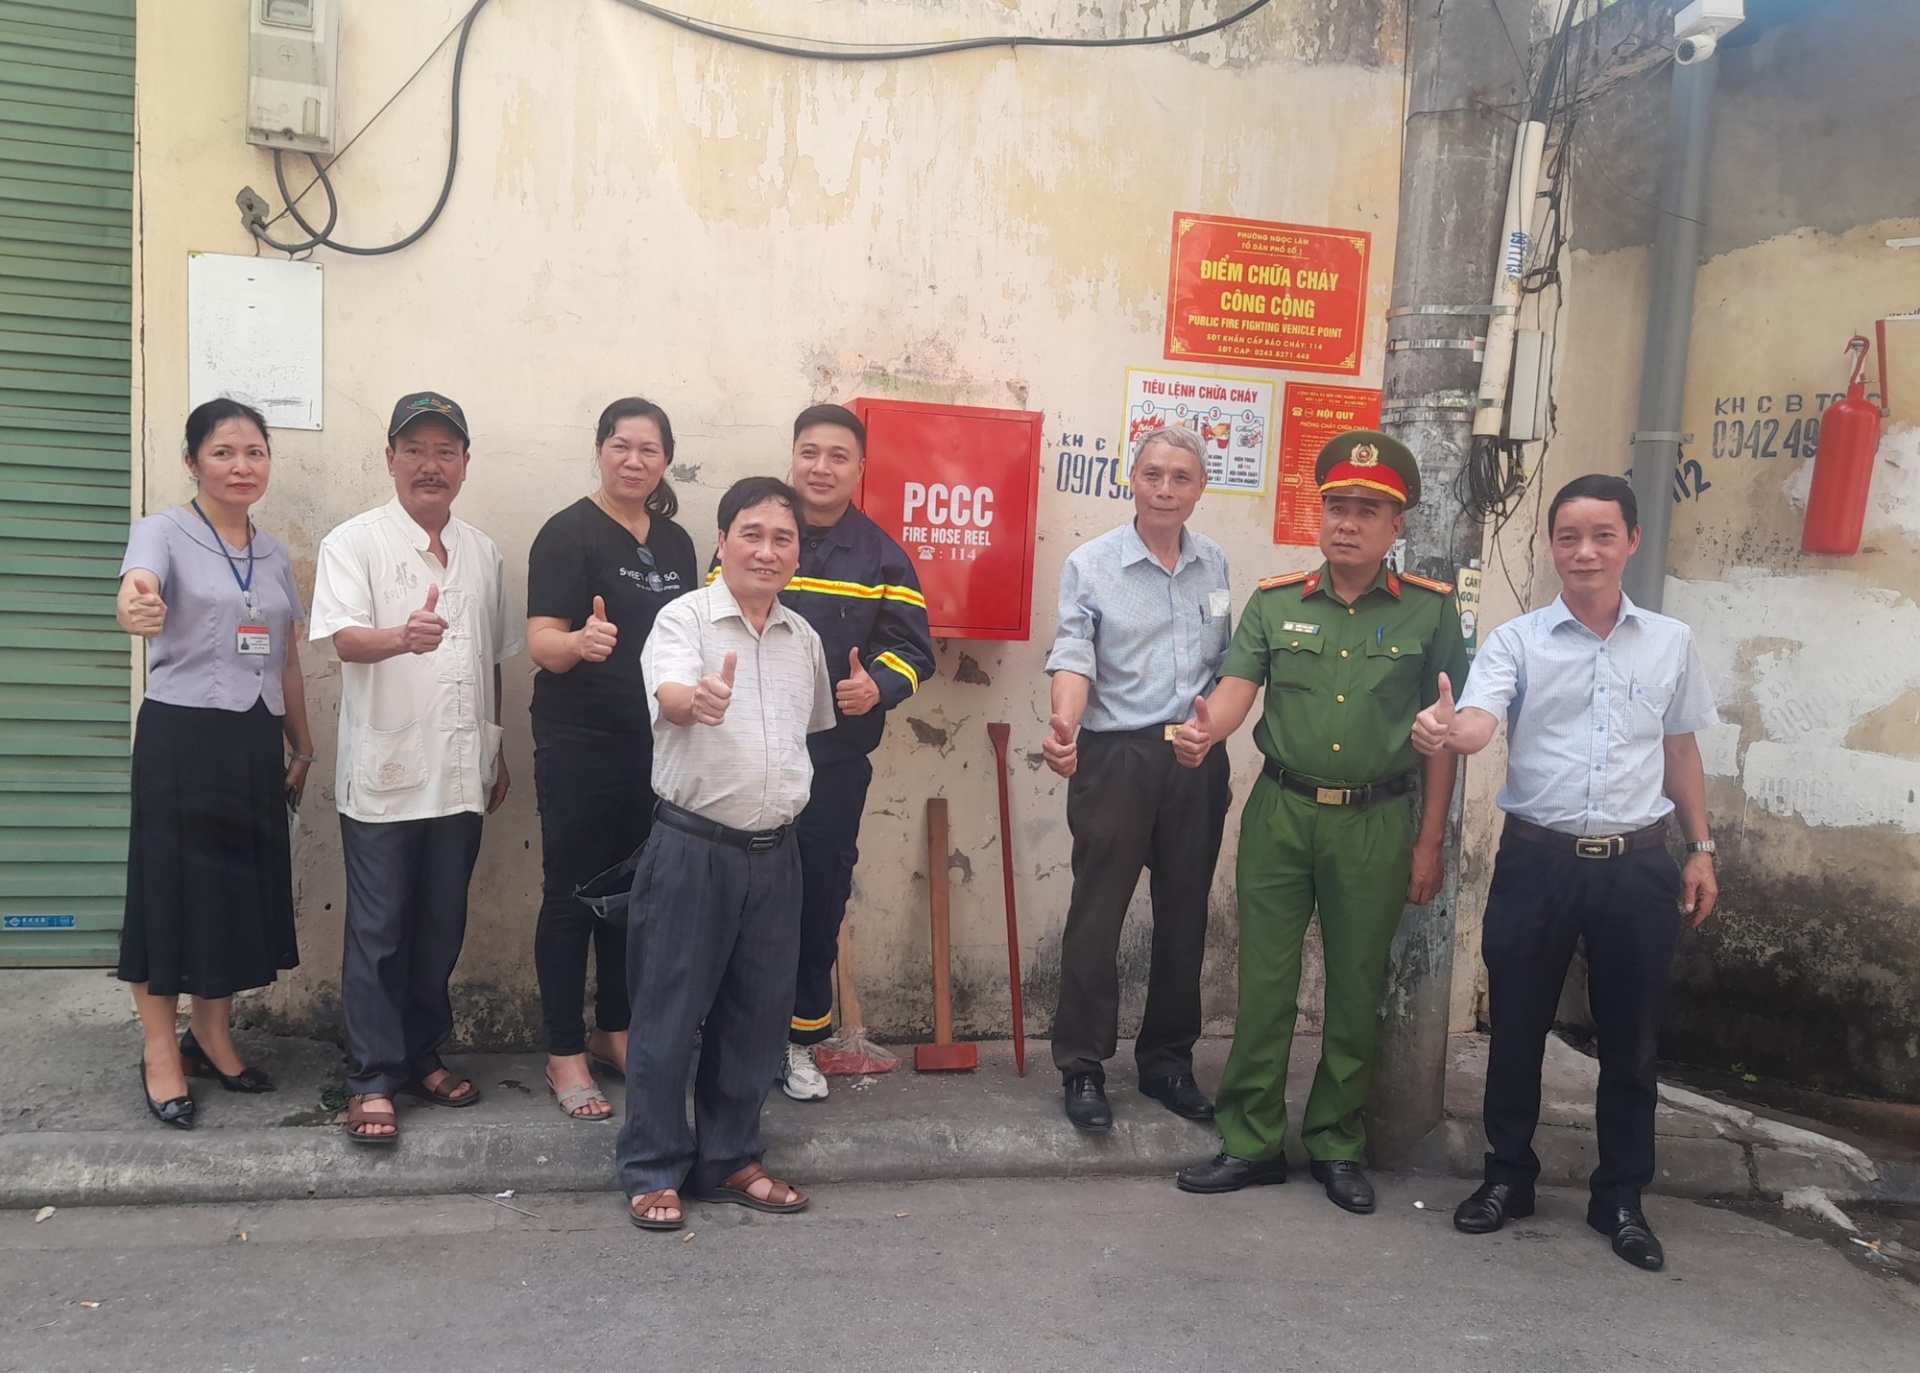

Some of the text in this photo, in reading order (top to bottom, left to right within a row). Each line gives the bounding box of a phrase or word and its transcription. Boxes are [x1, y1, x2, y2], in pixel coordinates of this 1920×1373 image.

[1200, 254, 1339, 292] ĐIỂM CHỮA CHÁY
[1220, 289, 1316, 320] CÔNG CỘNG
[1188, 314, 1343, 339] PUBLIC FIRE FIGHTING VEHICLE POINT
[1309, 342, 1323, 350] 114
[1142, 379, 1258, 403] TIÊU LỆNH CHỮA CHÁY
[1316, 408, 1355, 420] NỘI QUY
[1062, 433, 1083, 447] KH
[903, 482, 994, 528] PCCC
[903, 526, 991, 546] FIRE HOSE REEL
[950, 547, 976, 561] 114
